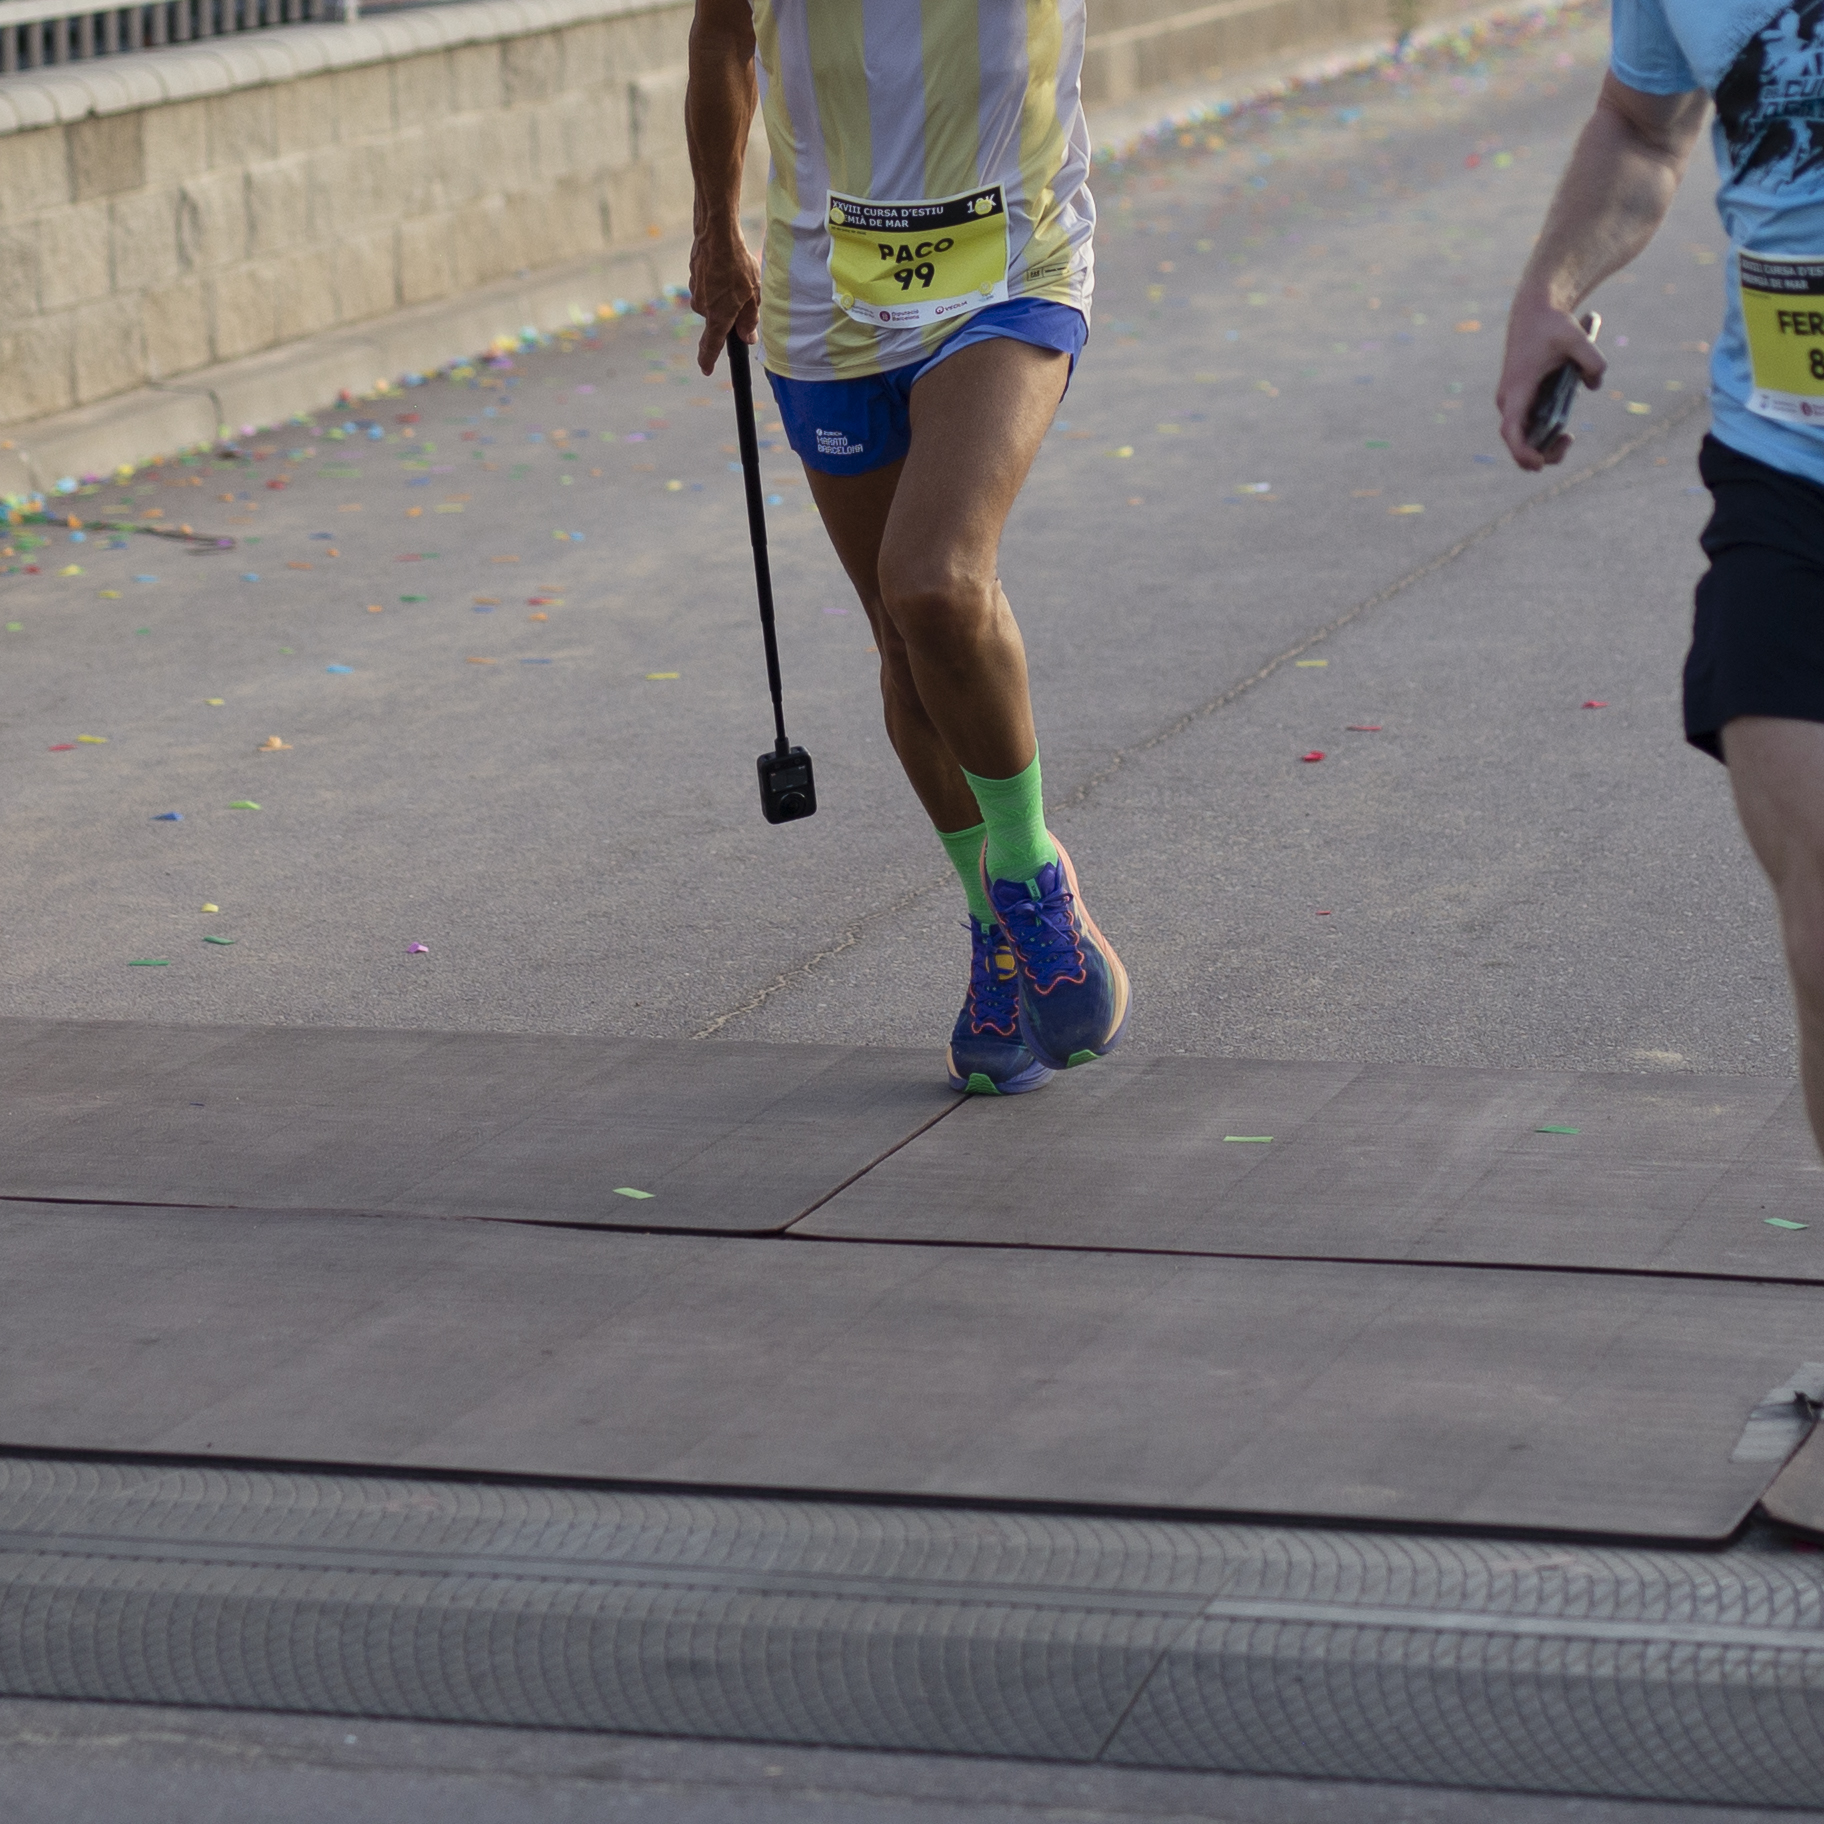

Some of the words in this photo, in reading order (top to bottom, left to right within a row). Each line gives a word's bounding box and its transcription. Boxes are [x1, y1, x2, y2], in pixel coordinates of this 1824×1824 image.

[864, 208, 898, 217] CURSA
[901, 206, 944, 217] D'ESTIU
[869, 219, 883, 227] DE
[885, 219, 909, 227] MAR
[878, 238, 954, 263] PACO
[894, 262, 935, 291] 99
[818, 444, 864, 455] BARCELONA
